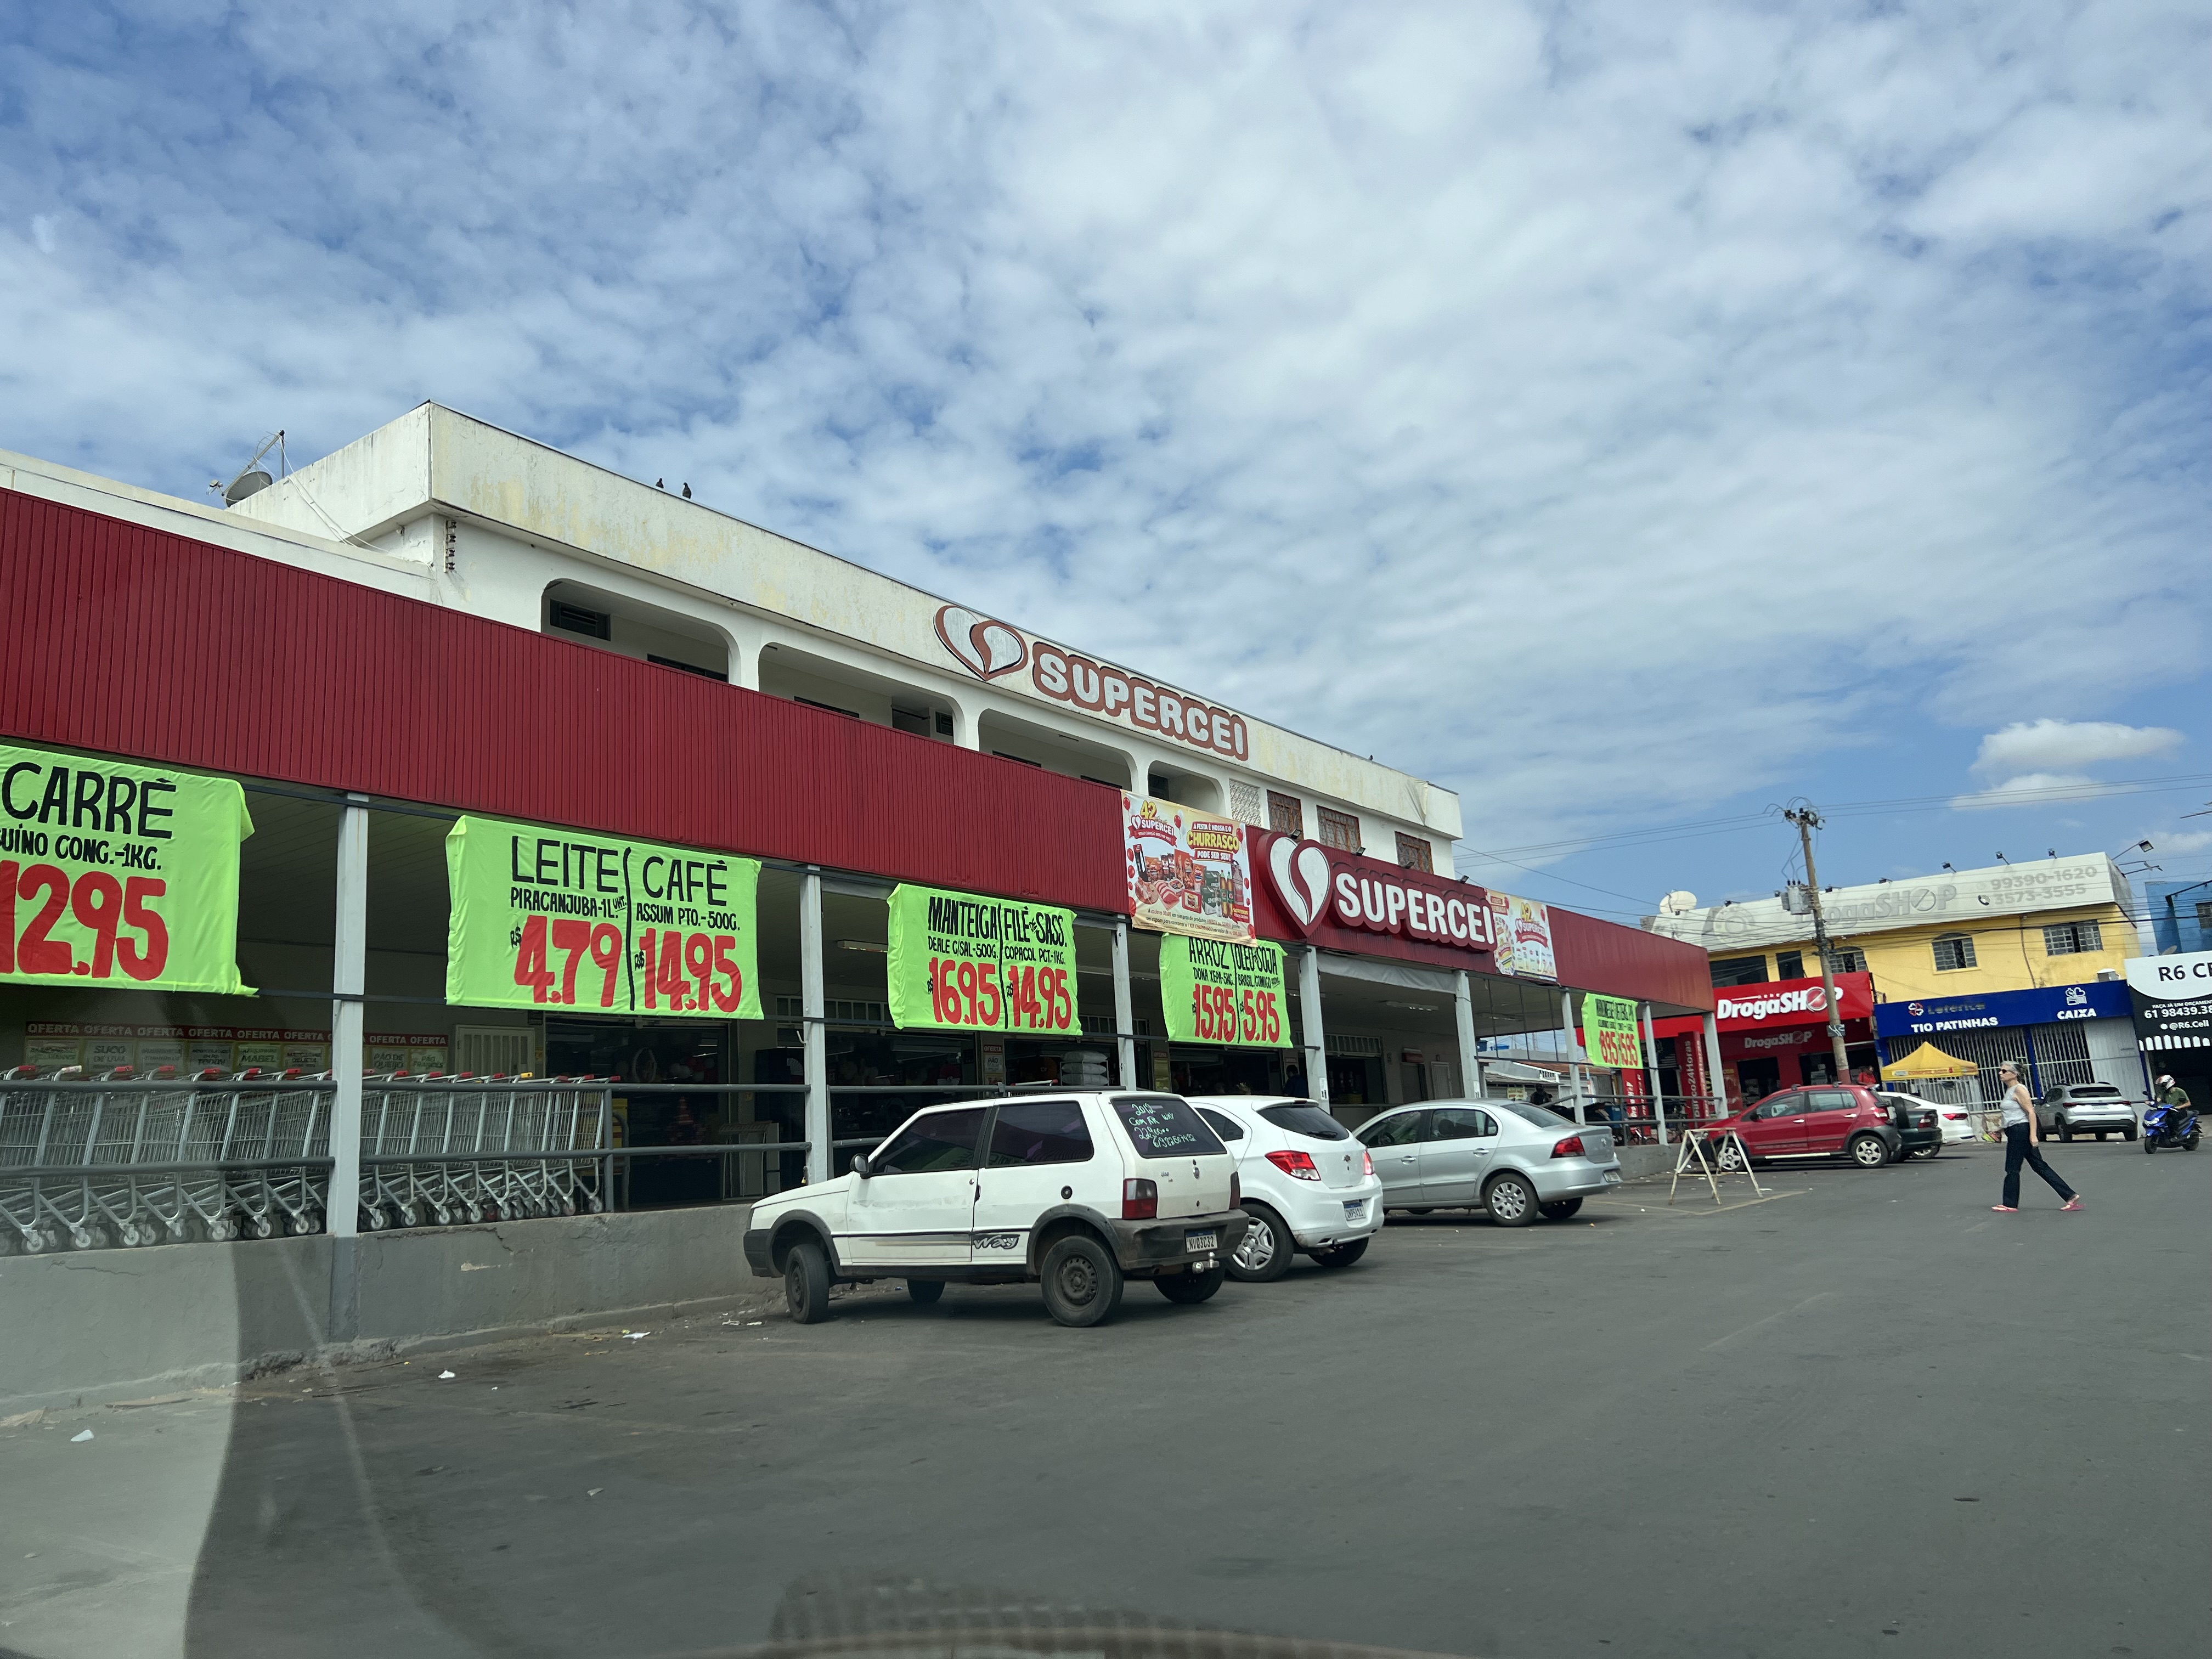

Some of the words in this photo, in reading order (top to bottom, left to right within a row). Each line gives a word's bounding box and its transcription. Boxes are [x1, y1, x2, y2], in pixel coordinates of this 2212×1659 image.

[1036, 648, 1245, 757] SUPERCEI
[1140, 800, 1157, 819] 42
[1142, 819, 1174, 836] SUPERCEI
[0, 823, 48, 856] UÍNO
[1187, 830, 1239, 850] CHURRASCO
[511, 836, 619, 893] LEITE
[1221, 853, 1231, 861] SEU!
[642, 856, 727, 906] CAFÉ
[1991, 866, 2097, 890] 99390-1620
[1994, 883, 2086, 905] 3573-3555
[636, 903, 674, 925] ASSUM
[1335, 872, 1495, 944] SUPERCEI
[1521, 902, 1532, 921] 42
[1796, 884, 1956, 929] ogaSHOP
[0, 860, 169, 980] 12.95
[928, 896, 998, 940] MANTEIGA
[1036, 912, 1067, 947] SASS.
[928, 935, 950, 954] DEALE
[1005, 945, 1036, 961] COPACOL
[1189, 936, 1229, 969] ARROZ
[514, 915, 623, 1007] 4.79
[1256, 946, 1278, 975] SOJA
[640, 928, 742, 1013] 14.95
[1193, 967, 1209, 981] DONA
[2158, 965, 2186, 981] R6
[929, 957, 1001, 1026] 16.95
[1008, 965, 1071, 1029] 14.95
[1193, 983, 1236, 1042] 15.95
[1243, 989, 1280, 1043] 5.95
[2057, 1008, 2097, 1020] CAIXA
[2144, 1009, 2158, 1018] 61
[2161, 1005, 2212, 1018] 98439.38
[28, 1024, 80, 1034] OFERTA
[84, 1025, 132, 1035] OFERTA
[138, 1028, 184, 1037] OFERTA
[189, 1028, 232, 1038] OFERTA
[1911, 1022, 1933, 1033] TIO
[1936, 1017, 1998, 1031] PATINHAS
[2169, 1020, 2209, 1030] @R6.Cell
[237, 1030, 280, 1040] OFERTA
[284, 1031, 324, 1041] OFERTA
[370, 1035, 407, 1045] OFERTA
[410, 1036, 446, 1045] OFERTA
[1744, 1031, 1812, 1048] DrogaSHOP
[1132, 1103, 1156, 1116] 2012
